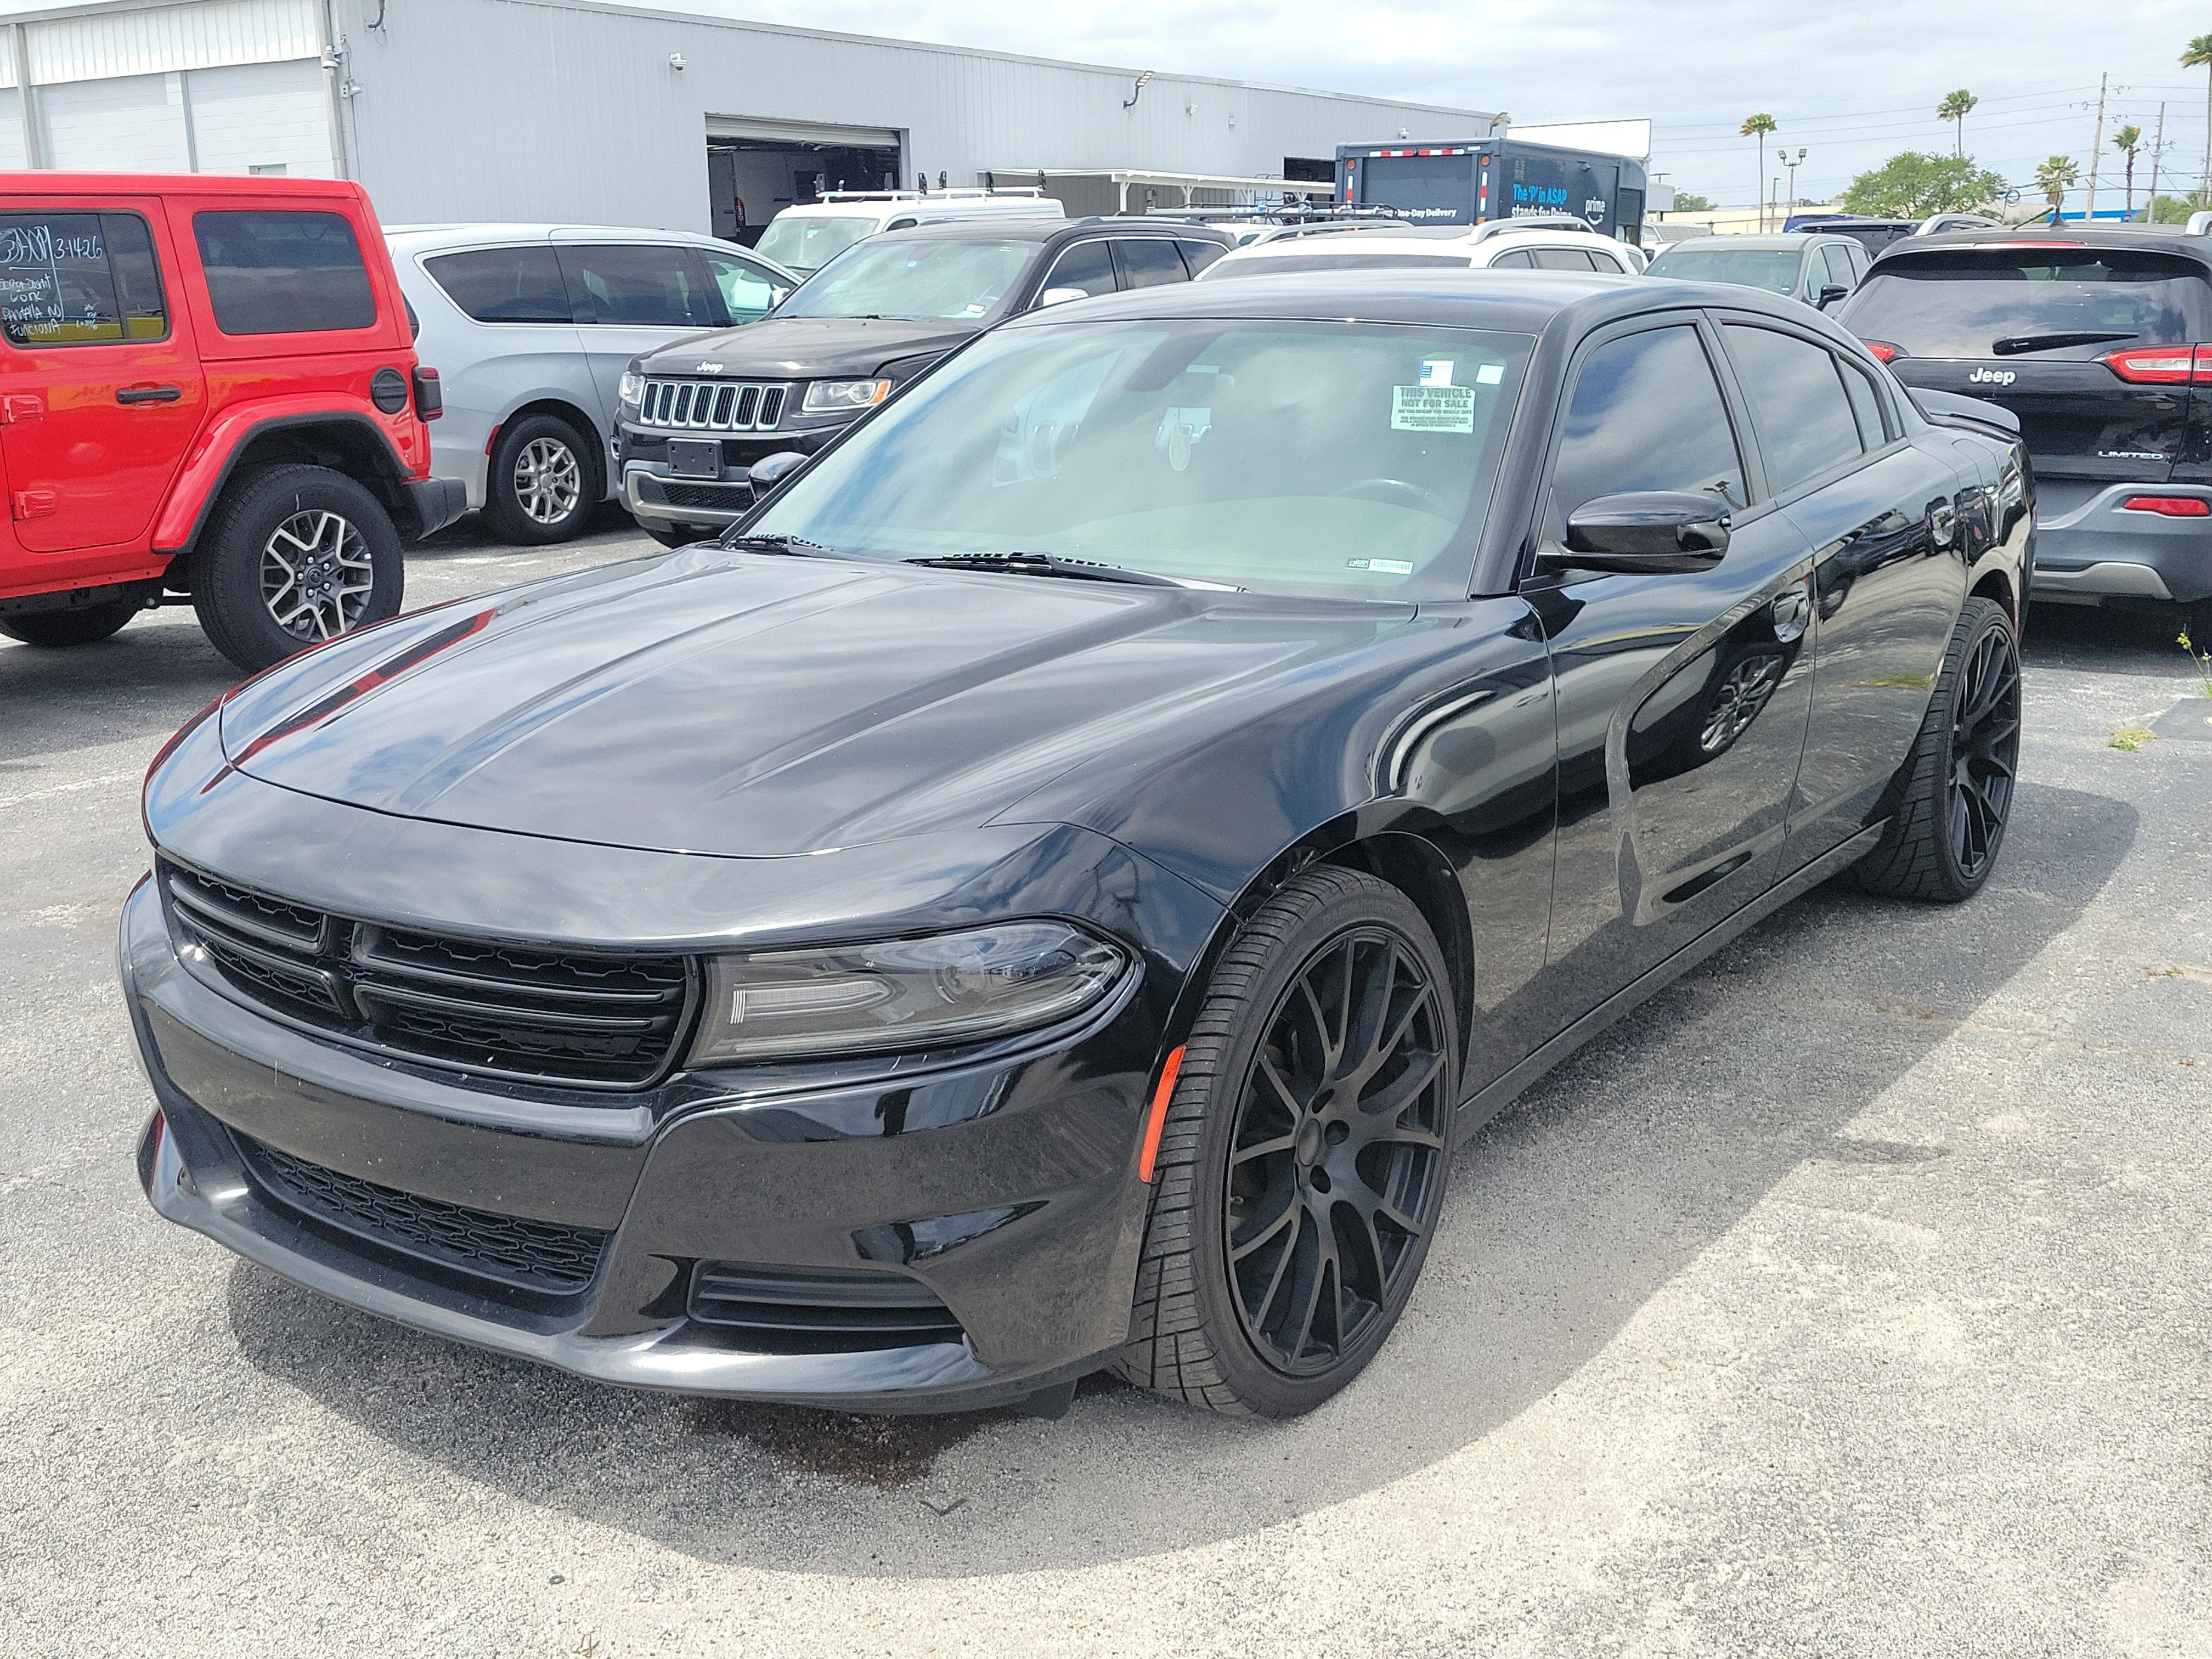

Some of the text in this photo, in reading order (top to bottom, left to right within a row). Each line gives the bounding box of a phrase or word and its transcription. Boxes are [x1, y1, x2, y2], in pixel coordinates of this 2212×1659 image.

[1513, 183, 1528, 201] The
[1538, 187, 1546, 202] in
[1547, 188, 1567, 204] ASAP
[1511, 204, 1537, 217] stands
[1585, 196, 1606, 215] prime
[1426, 208, 1457, 218] Delivery
[696, 360, 724, 374] Jeep
[1970, 367, 2016, 386] Jeep
[1400, 387, 1471, 398] THIS VEHICLE
[1401, 399, 1420, 407] NOT
[1423, 399, 1441, 408] FOR
[2098, 450, 2164, 460] LIMITED
